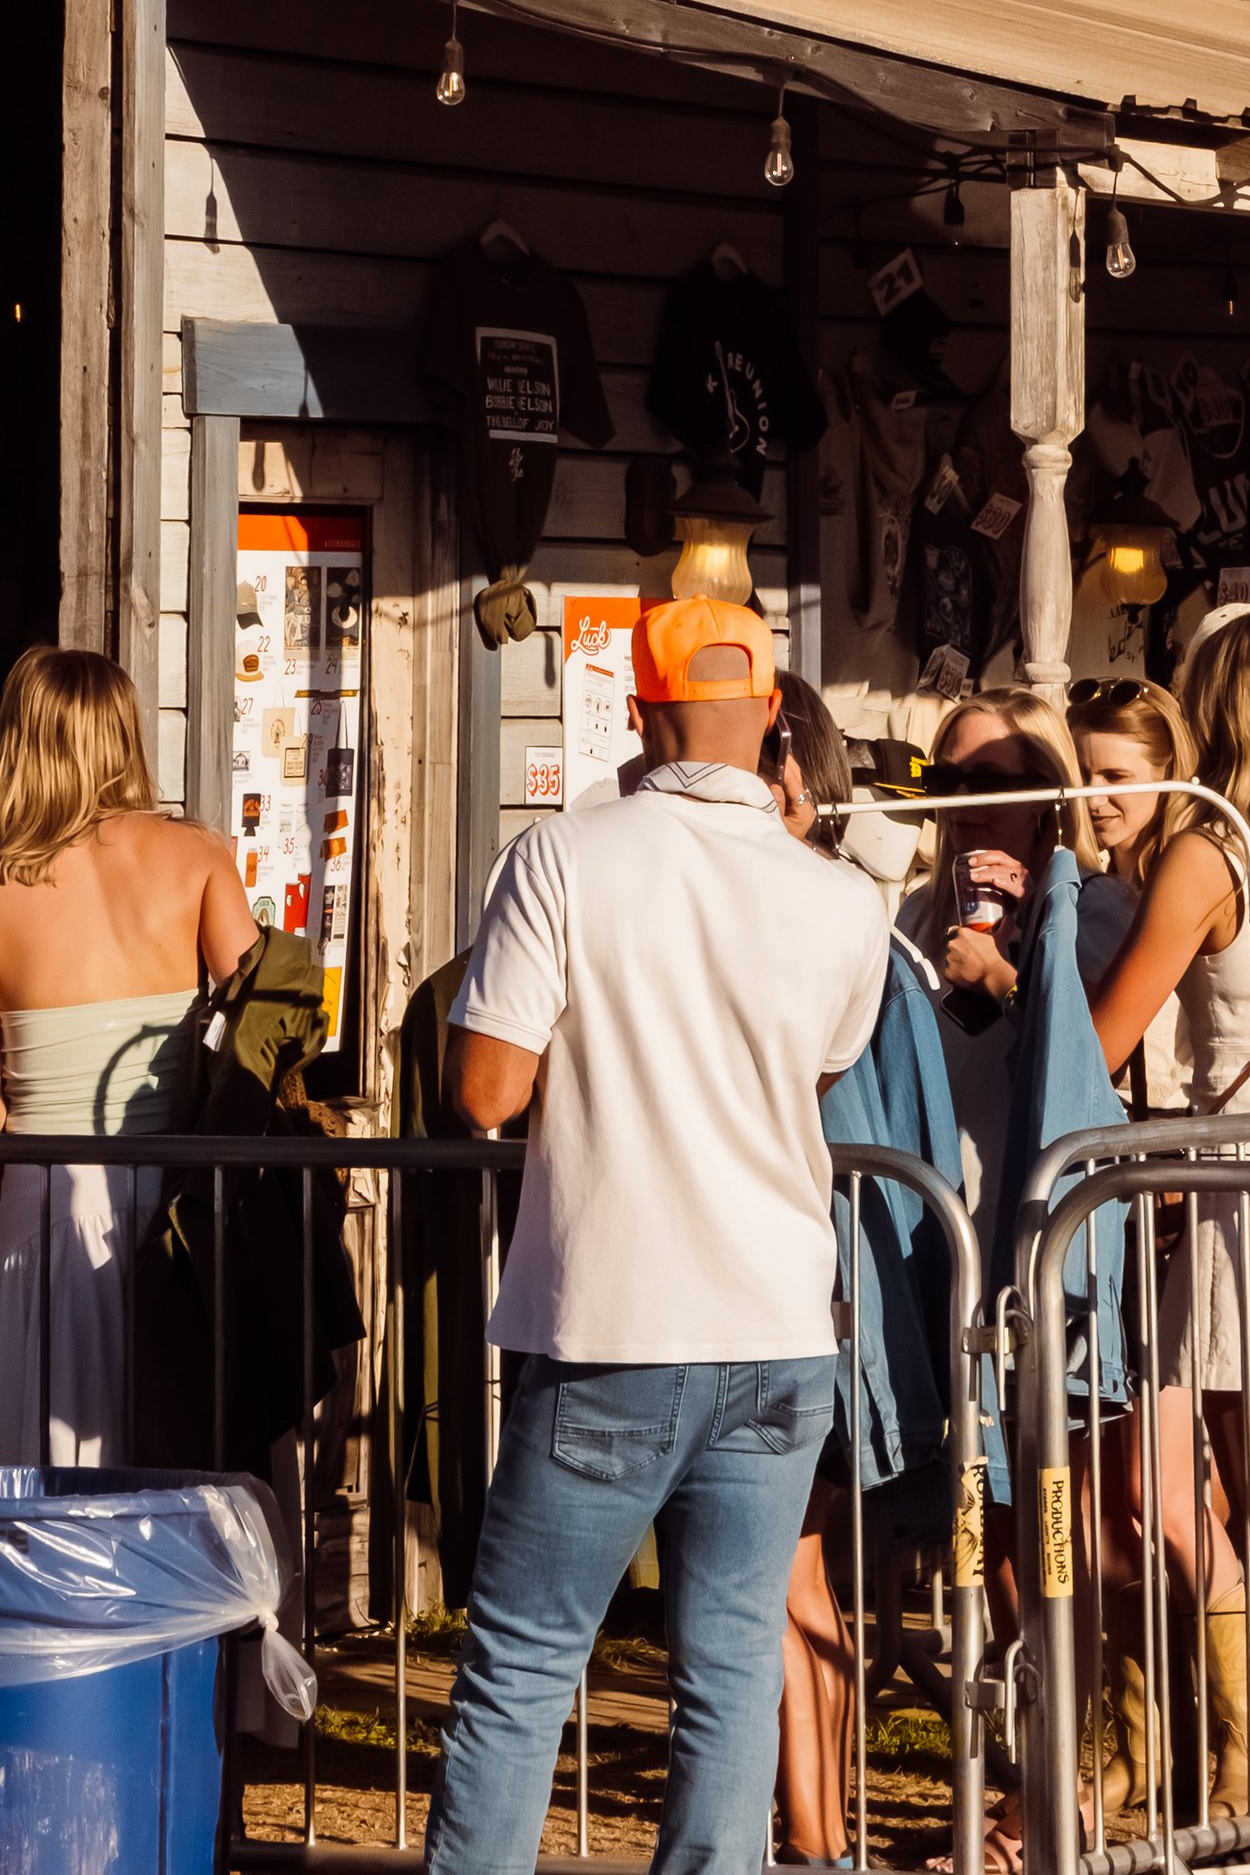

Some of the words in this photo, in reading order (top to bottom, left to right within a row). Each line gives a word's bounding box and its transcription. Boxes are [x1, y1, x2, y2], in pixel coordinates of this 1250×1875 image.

[254, 575, 267, 592] 20
[571, 615, 613, 656] Luck
[257, 636, 271, 653] 22
[284, 658, 297, 675] 23
[241, 697, 254, 715] 27
[527, 763, 560, 797] $35
[260, 795, 271, 812] 33
[257, 846, 270, 863] 34
[283, 837, 295, 855] 35
[1051, 1480, 1070, 1585] PRODUCTIONS
